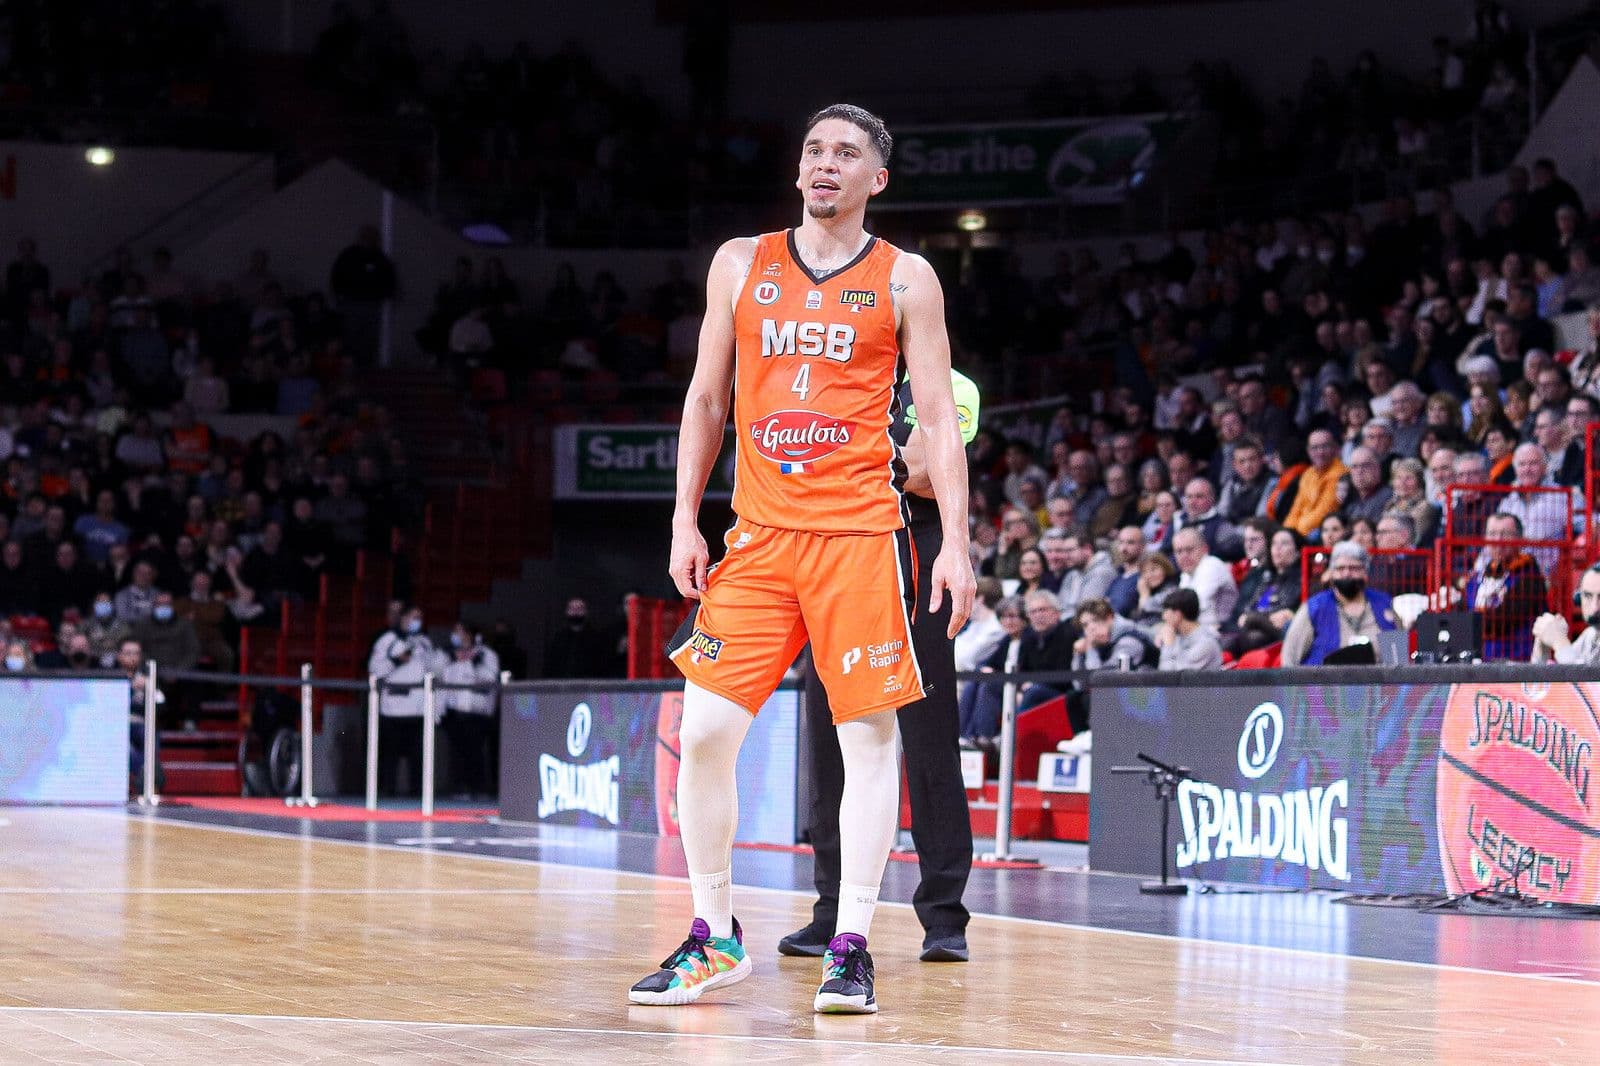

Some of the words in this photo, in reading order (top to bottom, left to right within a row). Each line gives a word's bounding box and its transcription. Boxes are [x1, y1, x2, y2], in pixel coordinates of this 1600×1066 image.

[900, 138, 1038, 175] Sarthe
[760, 287, 774, 300] U
[843, 291, 874, 305] Loué
[761, 318, 856, 362] MSB
[791, 363, 811, 401] 4
[762, 418, 850, 453] Gaulois
[867, 640, 903, 657] Sadrin
[869, 653, 901, 669] Rapin
[1469, 691, 1592, 808] SPALDING
[538, 753, 620, 825] SPALDING
[1176, 779, 1349, 880] SPALDING
[1467, 803, 1572, 892] LEGACY
